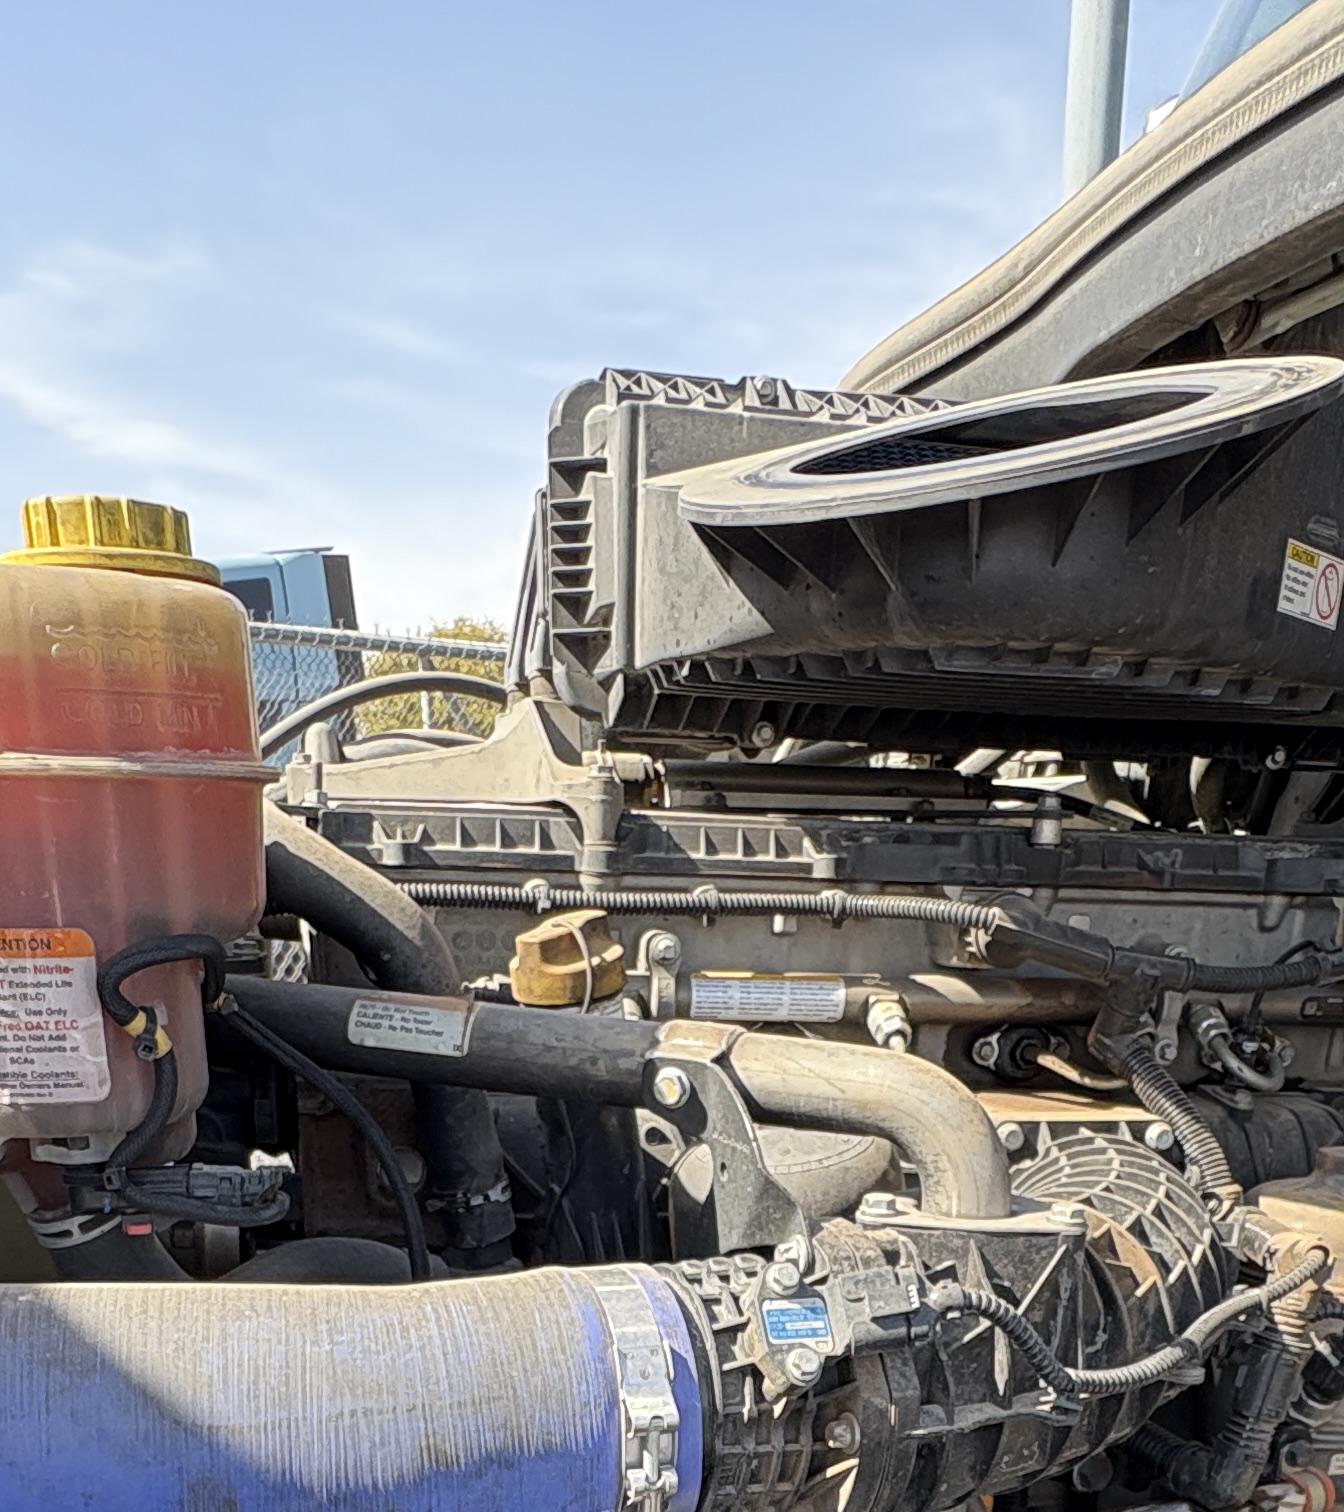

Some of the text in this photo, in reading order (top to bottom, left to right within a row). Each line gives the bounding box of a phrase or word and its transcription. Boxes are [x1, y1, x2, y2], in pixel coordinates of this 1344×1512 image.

[11, 966, 31, 974] with
[33, 964, 74, 974] Nitrite-
[8, 980, 53, 989] Extended
[55, 980, 73, 988] Life
[25, 1008, 44, 1016] Use
[45, 1007, 67, 1018] Only
[356, 1011, 395, 1022] CALIENTE
[25, 1020, 50, 1031] OAT
[55, 1019, 79, 1030] ELC
[354, 1020, 382, 1030] CHAUD
[400, 1026, 413, 1034] Pas
[414, 1027, 444, 1037] Toucher
[13, 1033, 26, 1041] Do
[29, 1033, 44, 1042] Not
[47, 1032, 67, 1042] Add
[26, 1045, 68, 1053] Coolants
